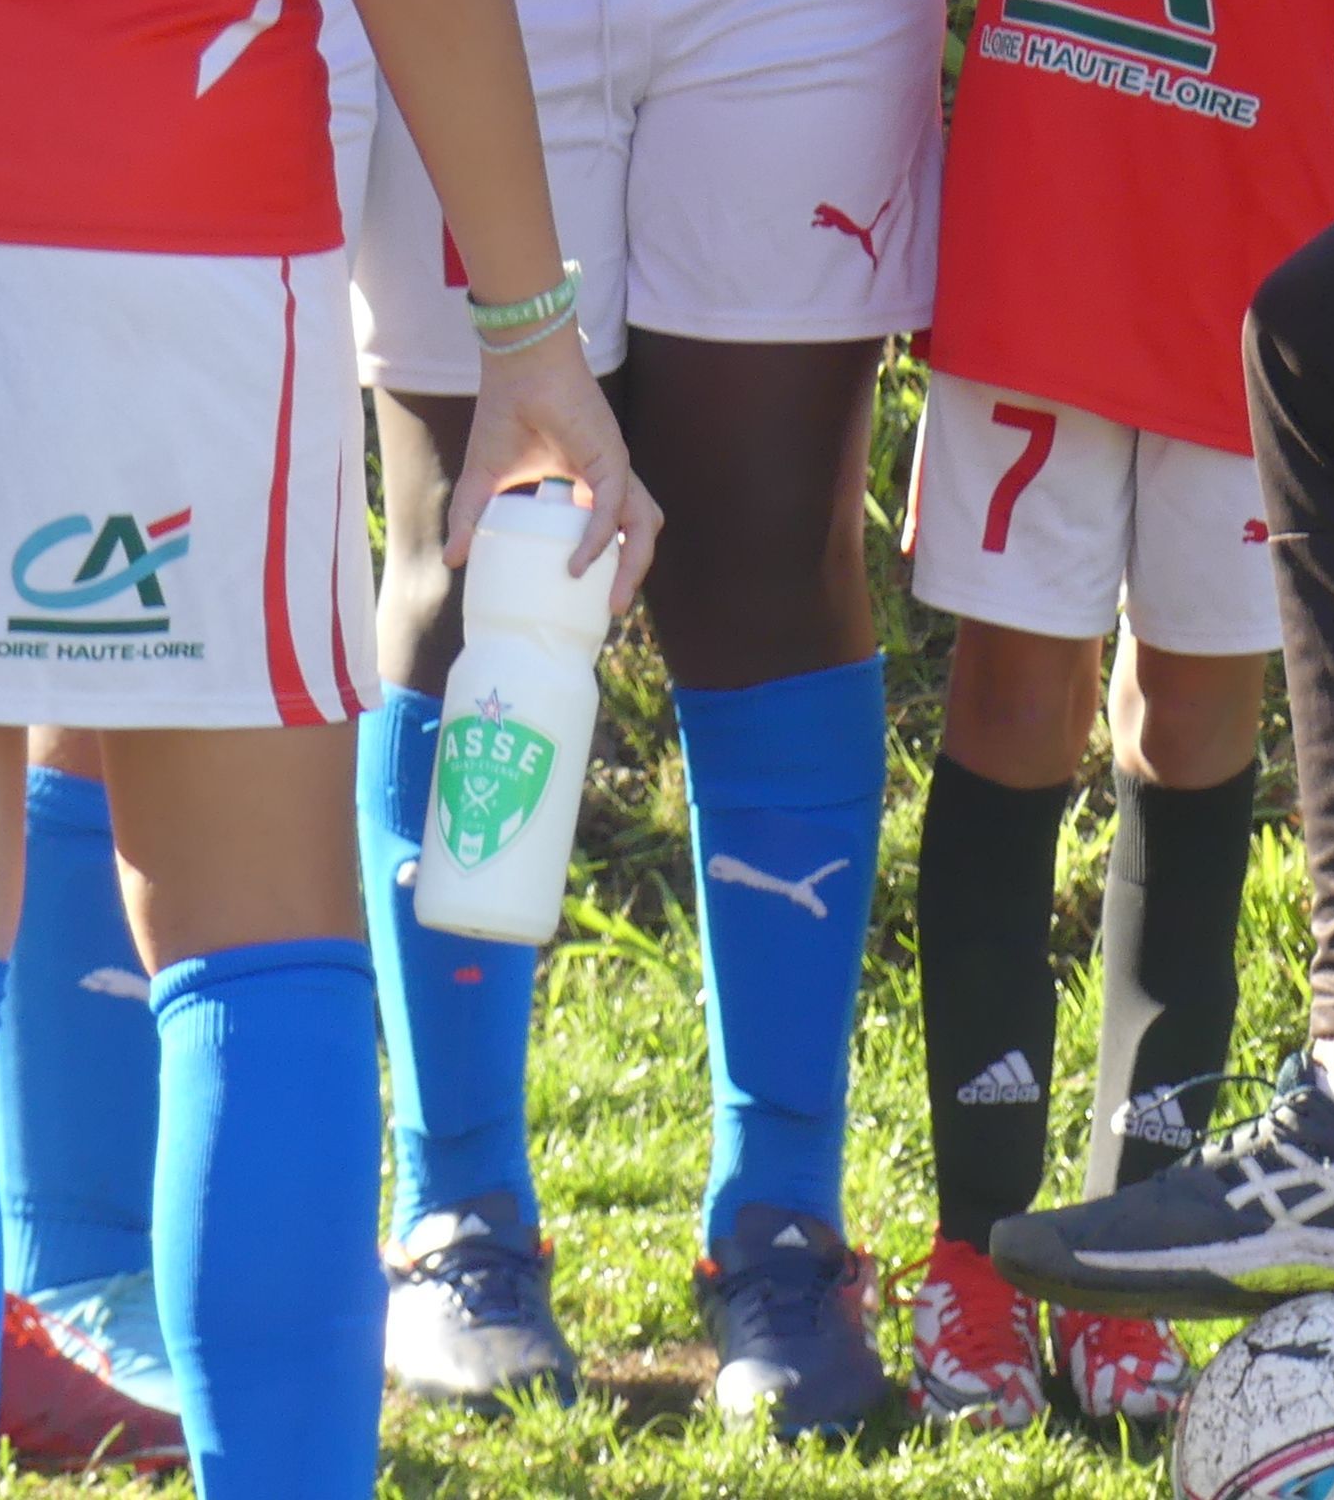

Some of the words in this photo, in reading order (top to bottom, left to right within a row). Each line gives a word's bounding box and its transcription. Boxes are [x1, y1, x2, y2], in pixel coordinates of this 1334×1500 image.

[980, 25, 1023, 61] LOIRE
[1026, 34, 1261, 128] HAUTE-LOIRE
[981, 402, 1057, 554] 7
[57, 641, 205, 661] HAUTE-LOIRE
[444, 726, 544, 775] ASSE
[956, 1082, 1041, 1104] adidas
